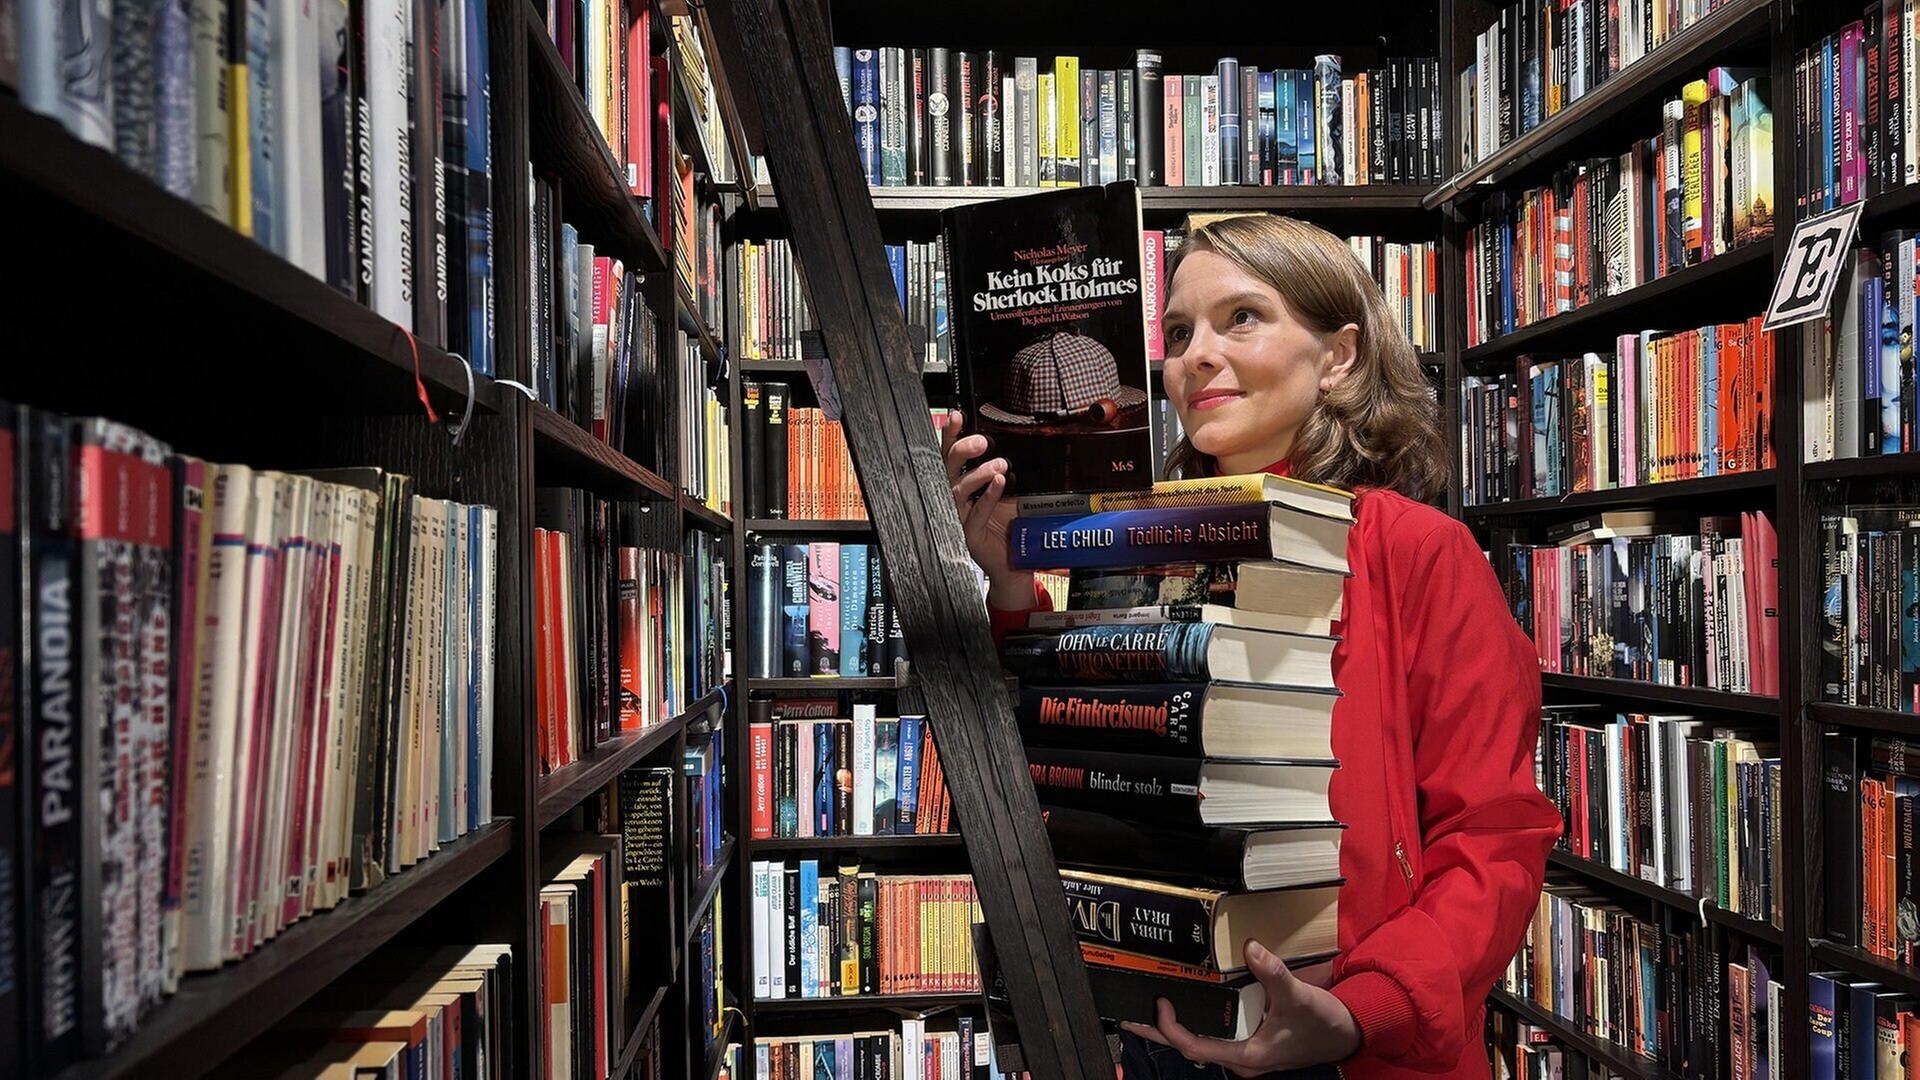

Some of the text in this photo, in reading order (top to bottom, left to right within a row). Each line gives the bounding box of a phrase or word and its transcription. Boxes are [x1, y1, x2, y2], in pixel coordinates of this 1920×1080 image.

[1867, 45, 1879, 124] ROTER ZAR
[1888, 40, 1899, 100] DER ROTE
[993, 118, 1001, 152] CONNELLY
[1102, 101, 1114, 138] CONNOLLY
[1667, 150, 1676, 178] Jimmy
[1690, 152, 1700, 200] VERLIERER
[358, 97, 373, 286] SANDRA BROWN
[397, 128, 412, 303] SANDRA BROWN
[434, 157, 447, 302] SANDRA BROWN
[1014, 243, 1088, 262] Nicholas Meyer
[1621, 236, 1629, 269] Demski
[1776, 227, 1842, 314] E
[486, 207, 495, 339] SANDRA BROWN
[987, 257, 1123, 291] Kein Koks für
[1146, 237, 1156, 320] NARKOSEMORD
[974, 278, 1137, 312] Sherlock Holmes
[1054, 301, 1106, 313] Erinnerungen
[1107, 299, 1122, 308] von
[1023, 500, 1052, 511] Massimo
[1044, 521, 1259, 549] LEE CHILD Tödliche Absicht
[343, 564, 353, 619] ERBARMEN
[791, 561, 803, 604] CORNWELL
[872, 558, 881, 597] DEFEKT
[342, 621, 350, 645] KEIN
[876, 603, 884, 643] Cornwell
[1056, 633, 1094, 652] JOHN
[1096, 637, 1109, 648] LE
[340, 648, 349, 690] KENNEN
[1056, 652, 1167, 671] MARIONETTEN
[40, 577, 72, 827] PARANOIA
[338, 692, 346, 709] SIE
[783, 704, 833, 718] Jerry Cotton
[1040, 697, 1168, 737] Die Einkreisung
[1169, 694, 1182, 738] CARR
[1178, 690, 1192, 744] CALEB
[902, 742, 913, 822] CATHERINE COULTER ANGST
[1027, 764, 1046, 783] DRA
[1049, 767, 1084, 789] BROWN
[1090, 771, 1132, 793] blinder
[1134, 777, 1164, 796] stolz
[1903, 798, 1912, 849] WOLFSNACHT
[1083, 884, 1103, 896] Aller
[1066, 897, 1120, 942] DIV
[1129, 922, 1173, 942] LIBBA
[1132, 907, 1170, 926] BRAY
[1732, 997, 1743, 1037] MEAT
[1812, 1025, 1833, 1037] Coup
[1817, 1014, 1833, 1023] Der
